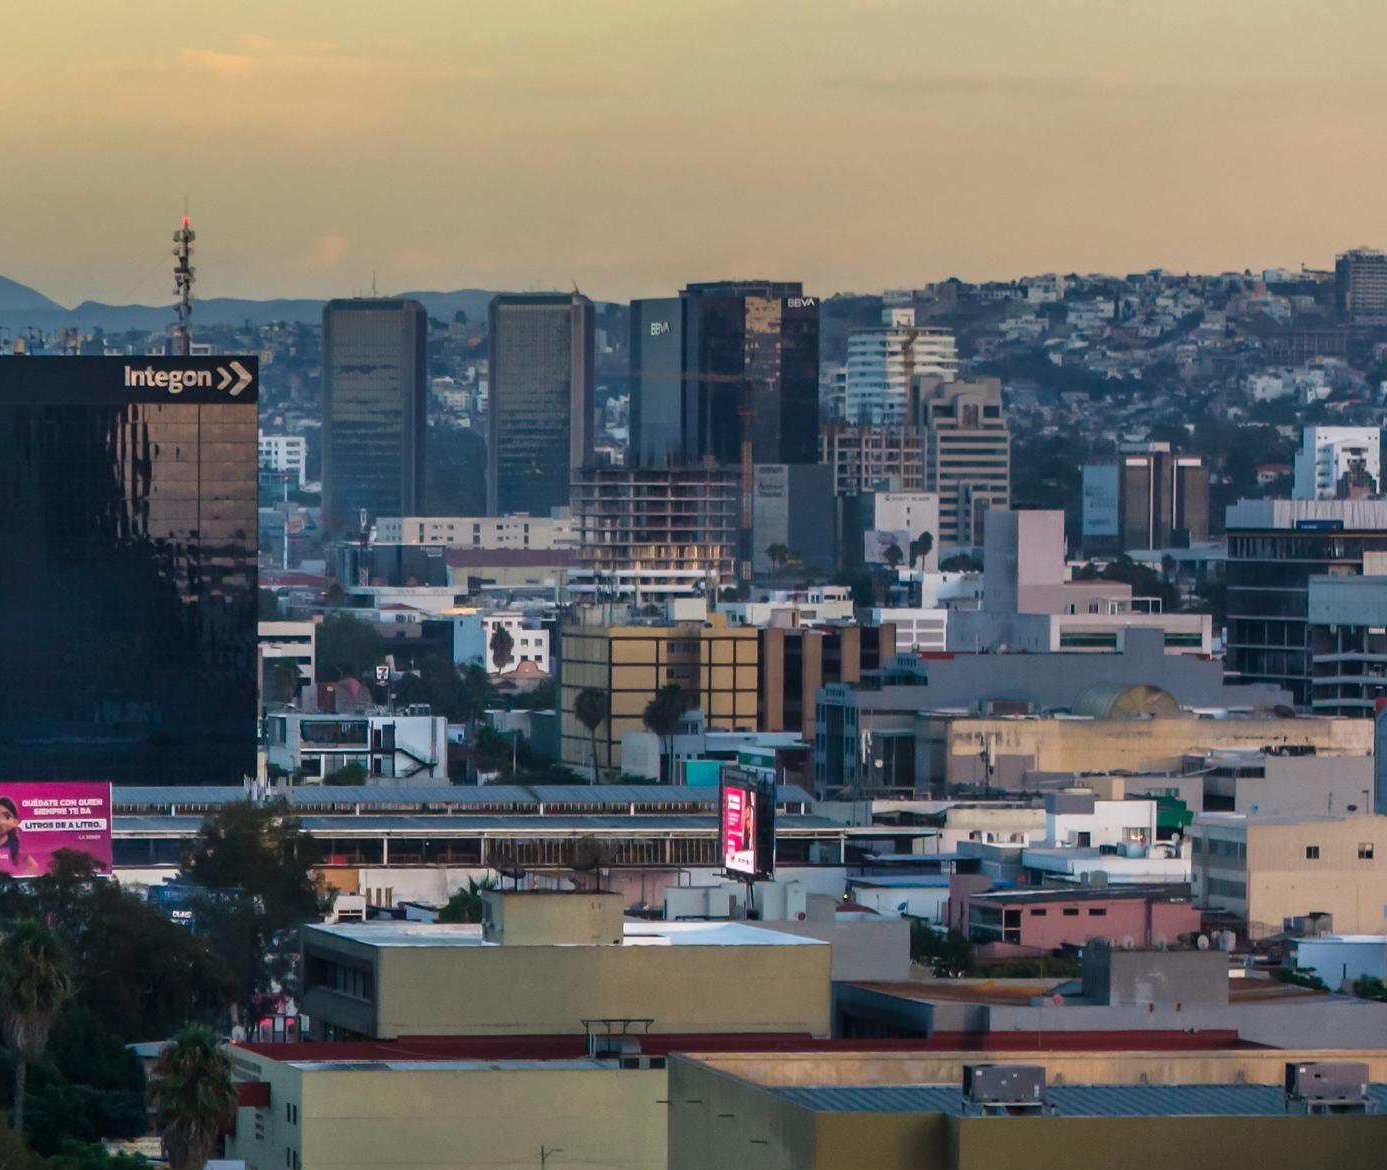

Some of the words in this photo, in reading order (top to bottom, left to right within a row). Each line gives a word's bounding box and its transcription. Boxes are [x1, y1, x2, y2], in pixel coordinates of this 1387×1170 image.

[787, 298, 815, 308] BBVA
[651, 322, 670, 336] BBVA
[125, 366, 212, 395] Integon
[25, 822, 55, 830] LITROS
